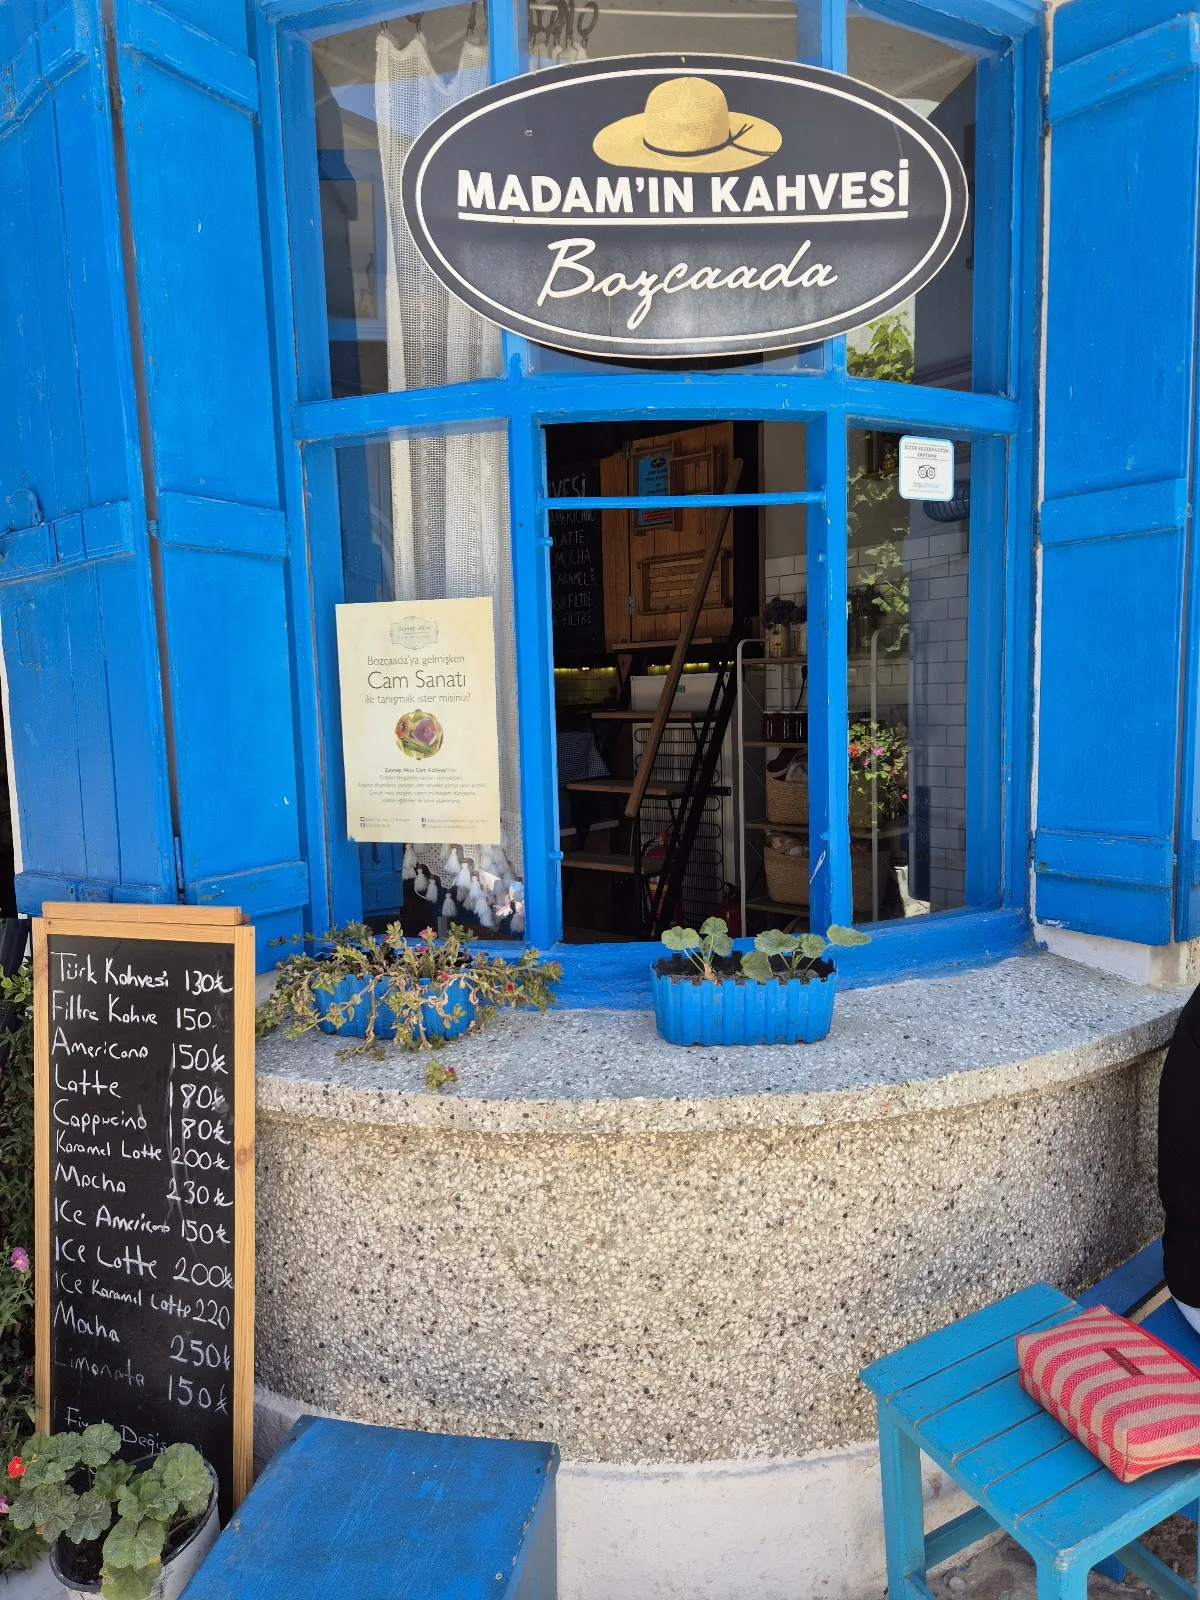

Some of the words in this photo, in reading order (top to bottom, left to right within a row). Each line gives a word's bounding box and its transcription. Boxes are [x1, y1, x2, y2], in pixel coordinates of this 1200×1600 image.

[457, 169, 695, 213] MADAM'IN
[711, 159, 909, 213] KAHVESİ
[537, 237, 838, 330] Bozcaada
[367, 655, 419, 667] Bozcaada'ya
[421, 653, 465, 667] gelmişken
[367, 671, 409, 690] Cam
[415, 669, 466, 689] Sanatı
[364, 694, 375, 704] ile
[377, 693, 416, 706] tanışmak
[417, 693, 437, 703] ister
[438, 692, 471, 702] misiniz?
[50, 951, 98, 985] Türk
[105, 957, 169, 988] Kahvesi
[52, 989, 99, 1021] Filtre
[108, 993, 158, 1024] Kahve
[51, 1025, 149, 1060] Americano
[55, 1063, 122, 1099] Latte
[56, 1128, 111, 1157] Karamel
[121, 1139, 162, 1161] Latte
[54, 1161, 126, 1193] Mocha
[96, 1244, 158, 1279] Latte
[192, 1298, 230, 1330] 220
